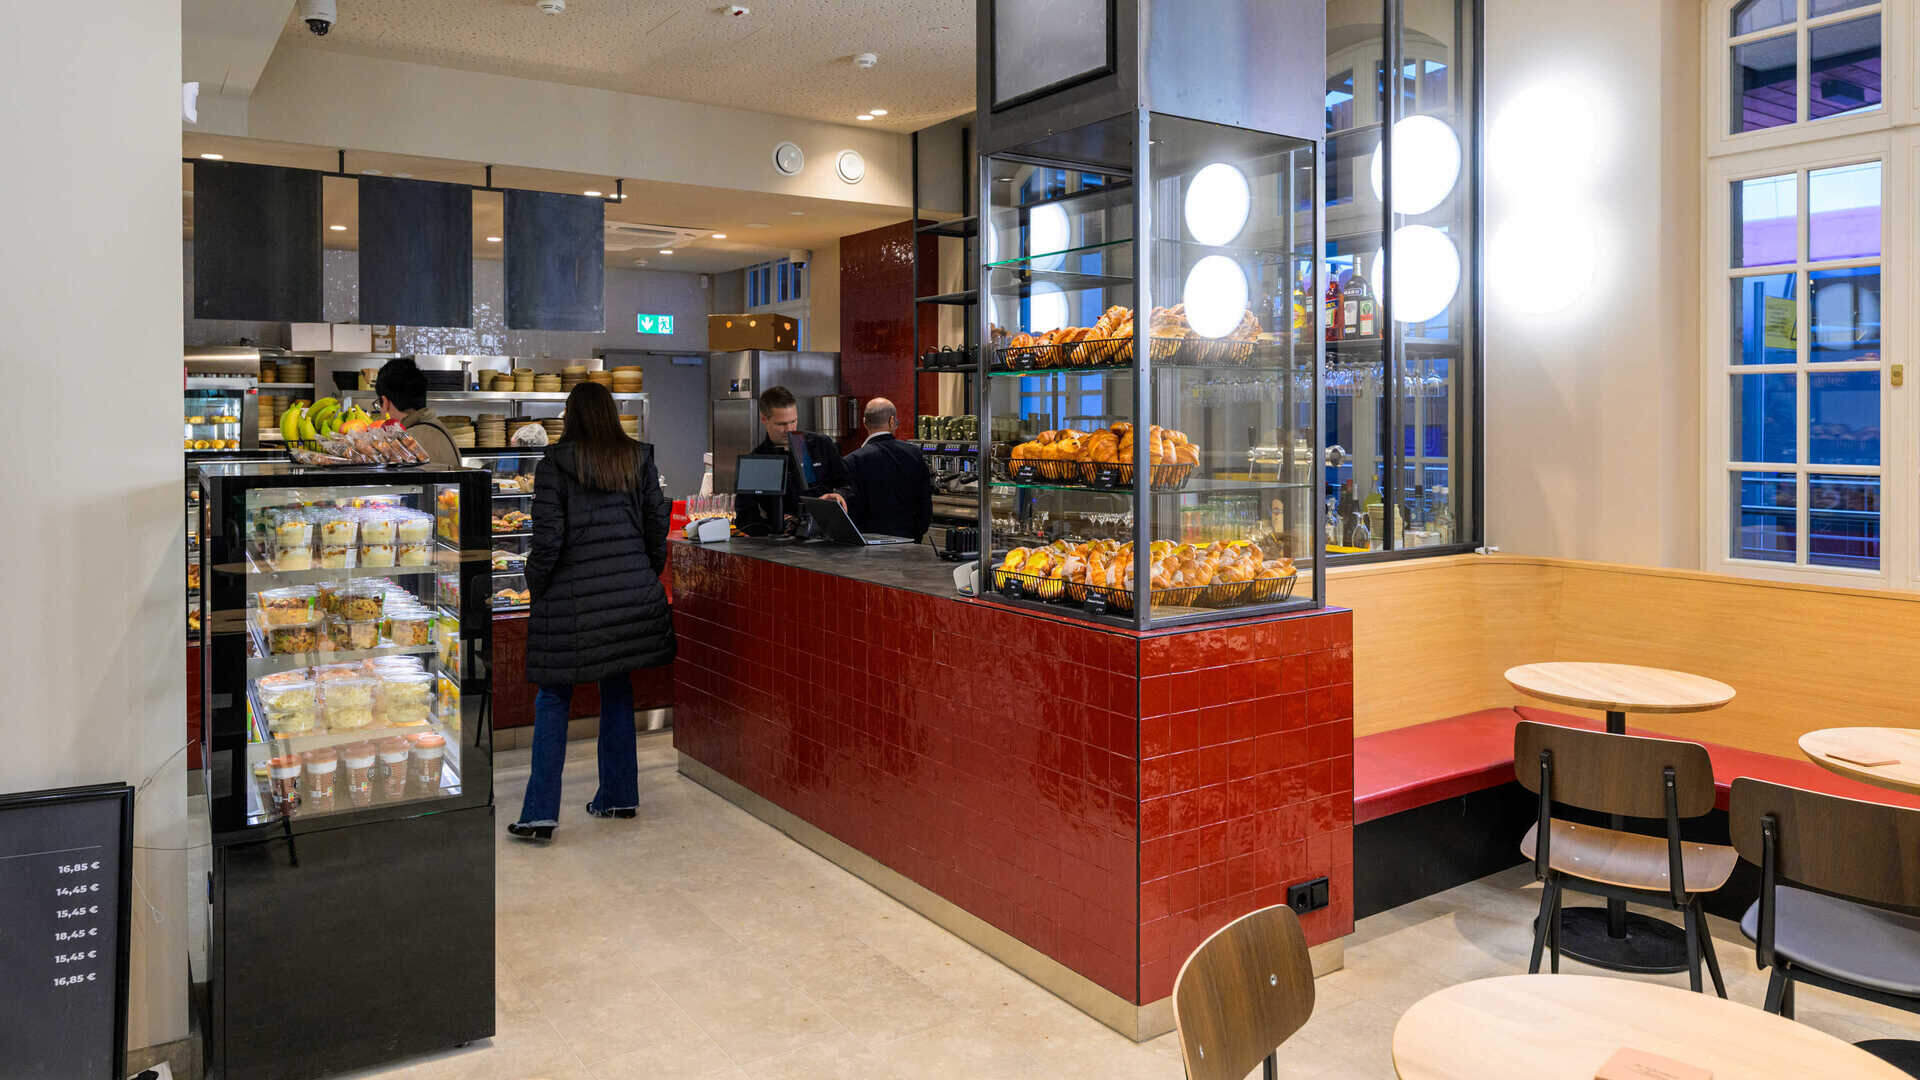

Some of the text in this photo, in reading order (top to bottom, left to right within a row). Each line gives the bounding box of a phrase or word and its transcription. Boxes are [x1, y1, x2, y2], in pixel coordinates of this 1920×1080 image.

[57, 861, 101, 874] 16,85 €
[56, 883, 100, 897] 14,45 €
[56, 905, 99, 919] 15,45 €
[55, 927, 98, 941] 18,45 €
[54, 950, 97, 964] 15,45 €
[53, 972, 97, 987] 16,85 €
